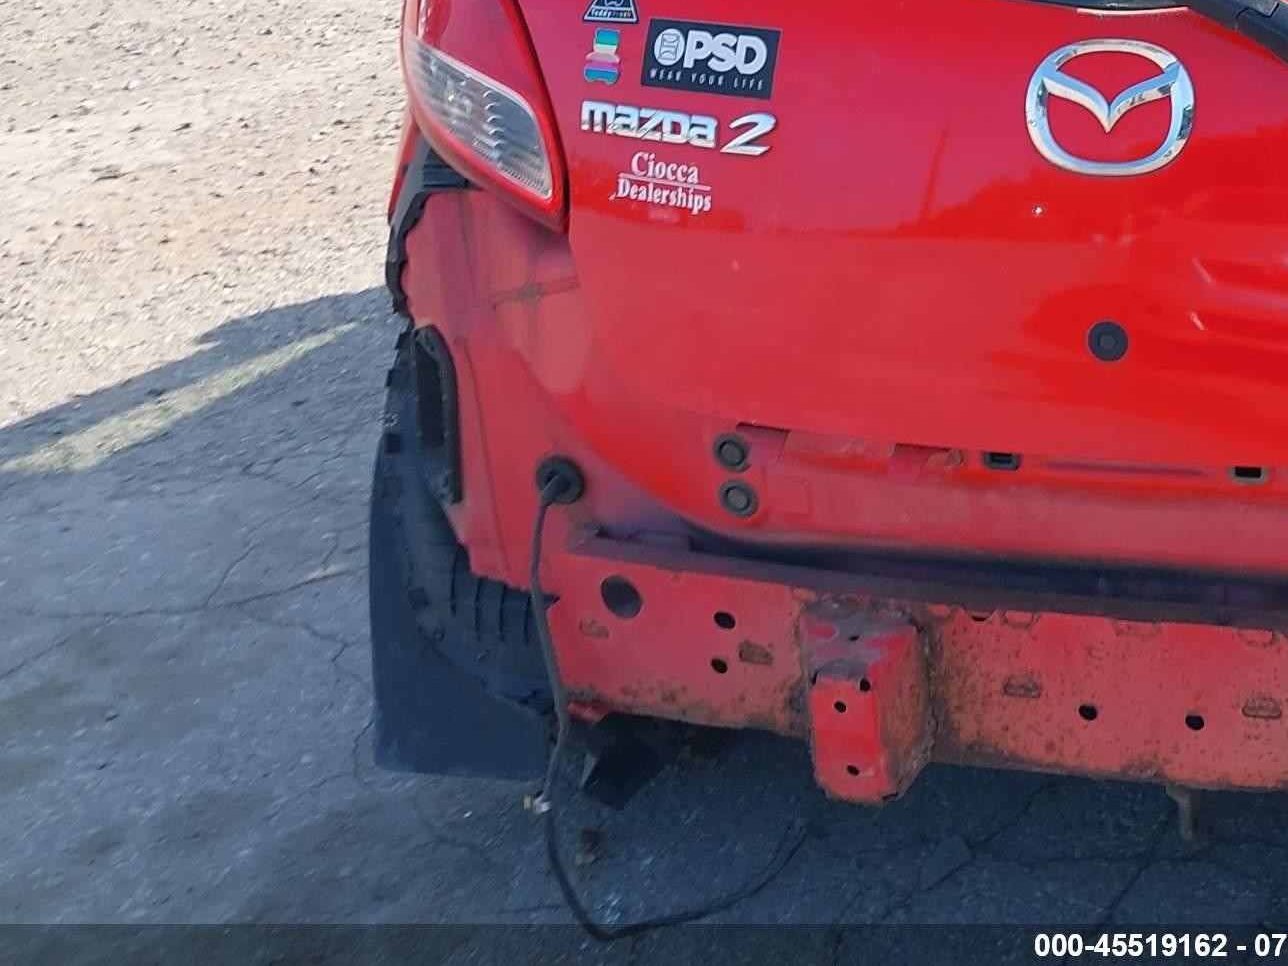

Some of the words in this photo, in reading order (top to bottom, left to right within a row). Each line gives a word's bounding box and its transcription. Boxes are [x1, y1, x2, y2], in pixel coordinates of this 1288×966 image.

[682, 29, 768, 75] PSD
[650, 67, 683, 82] WEAR
[691, 72, 725, 88] YOUR
[733, 75, 765, 91] LIFE
[719, 111, 777, 156] 2
[630, 151, 700, 185] Ciocca
[616, 177, 712, 215] Dealerships
